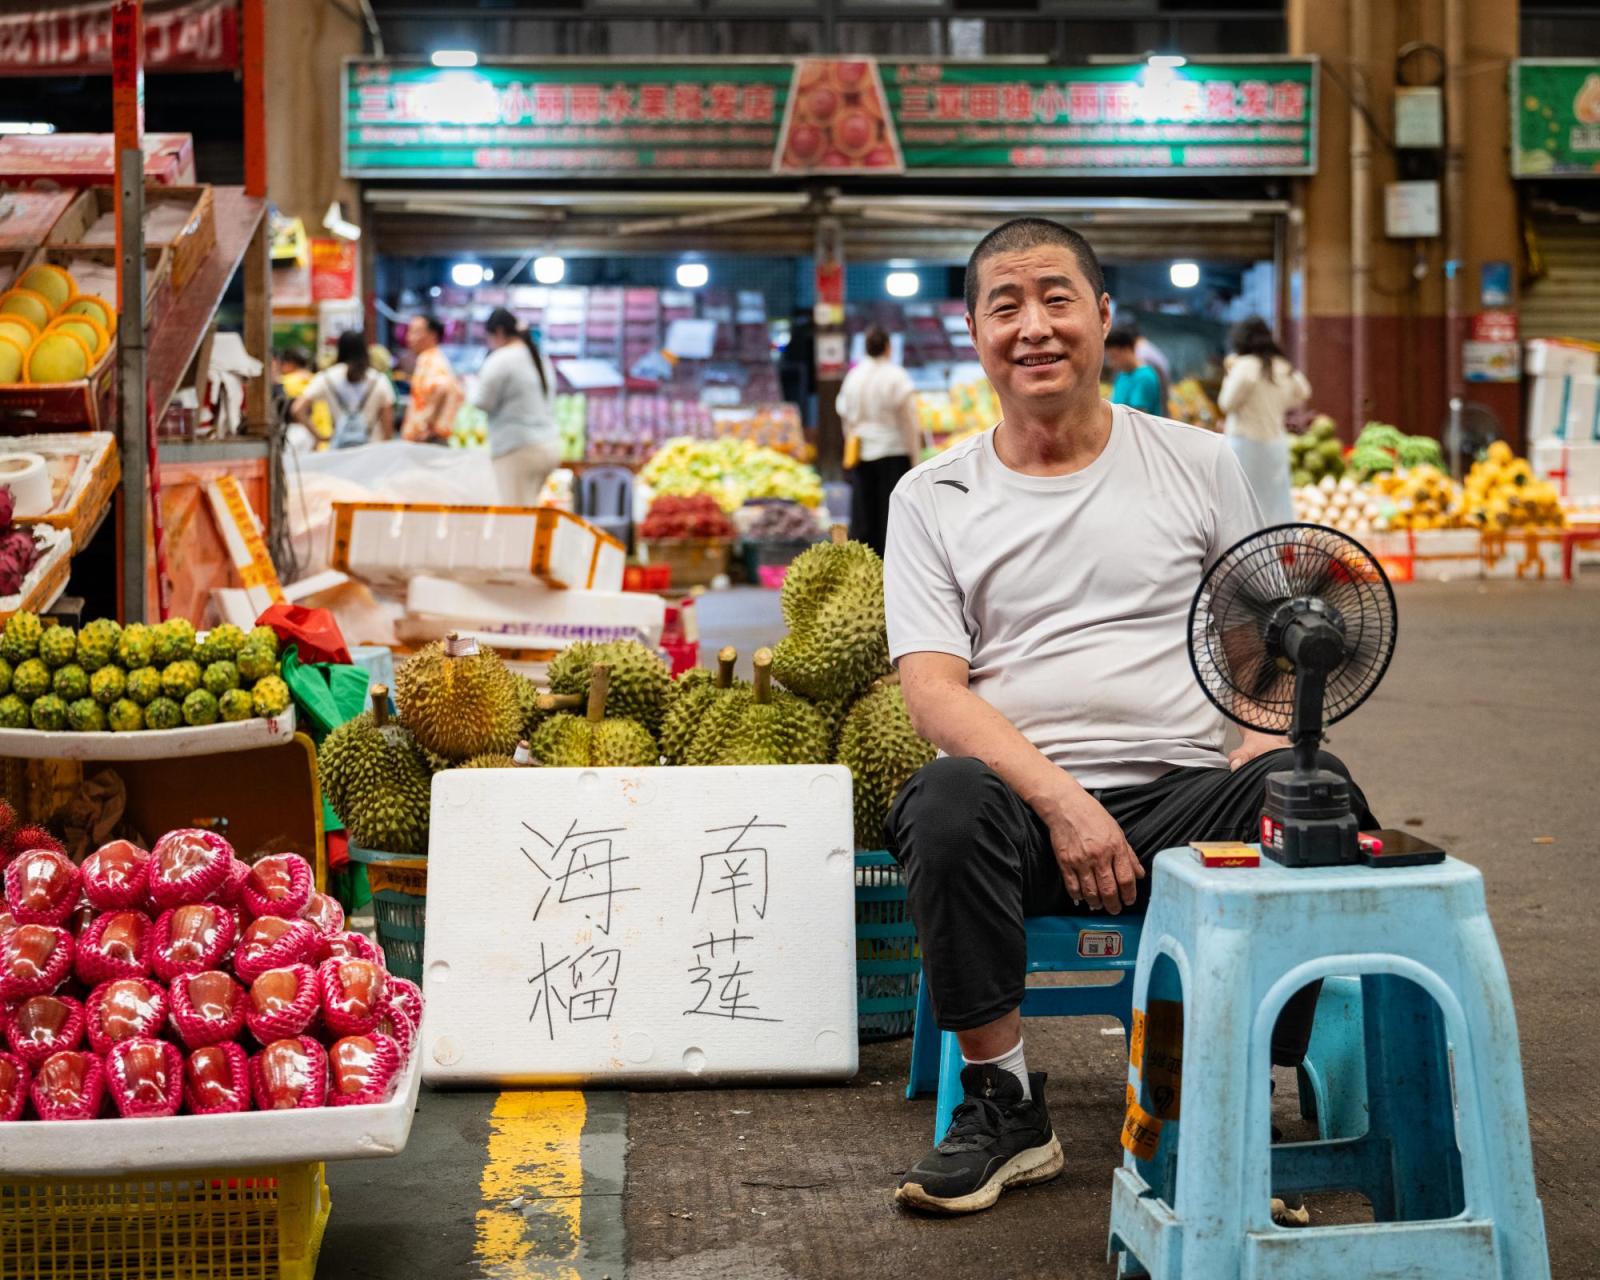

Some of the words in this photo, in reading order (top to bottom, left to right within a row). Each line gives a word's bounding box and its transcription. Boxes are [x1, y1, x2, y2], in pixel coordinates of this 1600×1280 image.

[357, 82, 775, 123] 三亚小丽丽水果批发店
[899, 81, 1306, 122] 三亚田独小丽丽批发店
[520, 814, 787, 935] 海南
[528, 928, 784, 1041] 榴莲
